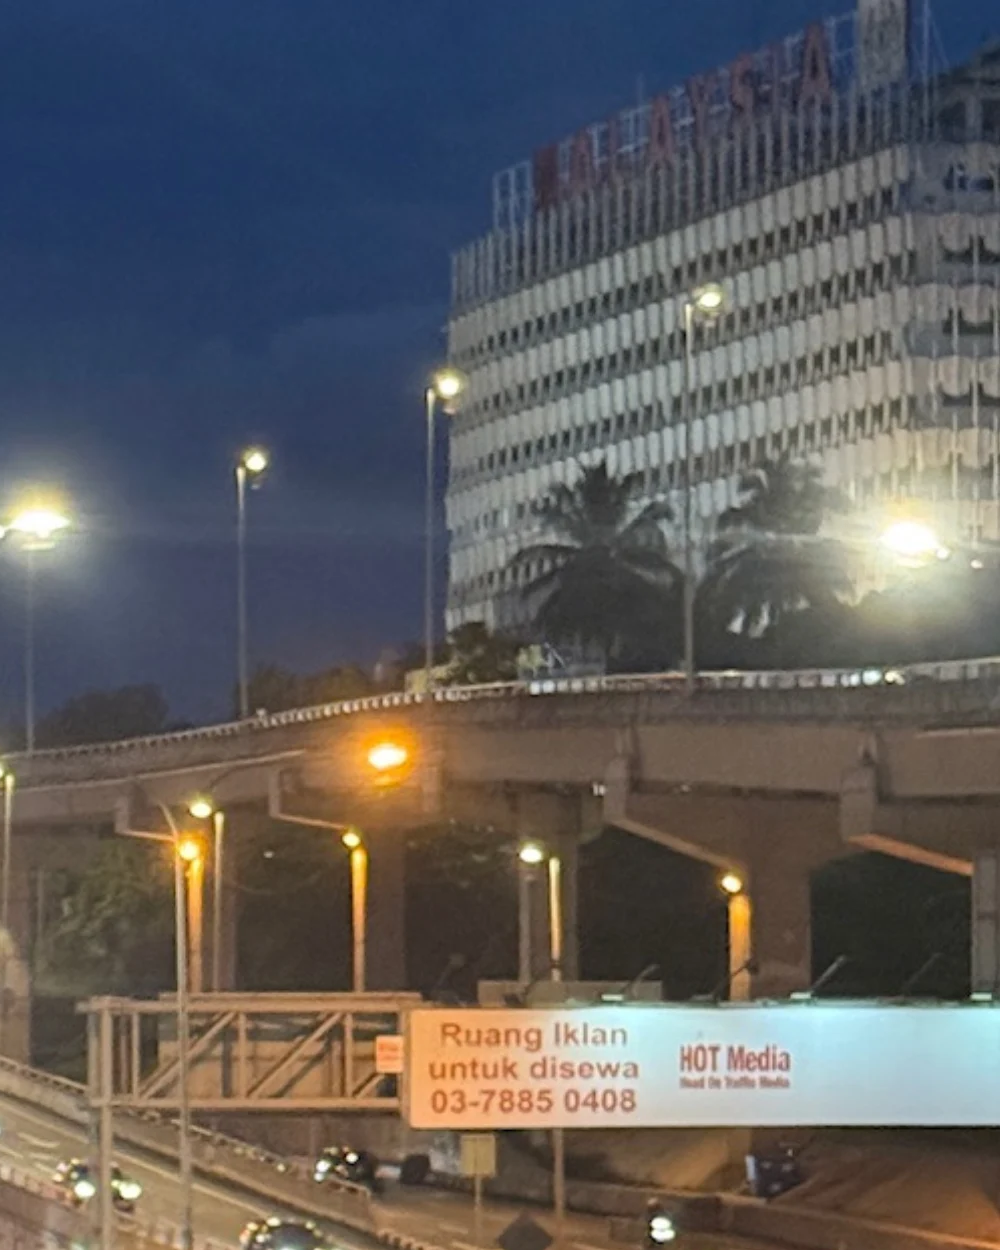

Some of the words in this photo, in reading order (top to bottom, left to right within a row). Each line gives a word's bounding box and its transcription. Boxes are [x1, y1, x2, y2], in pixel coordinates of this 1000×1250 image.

[440, 1022, 542, 1052] Ruang
[554, 1022, 628, 1046] Iklan
[428, 1057, 518, 1080] untuk
[530, 1056, 639, 1080] disewa
[680, 1044, 719, 1072] HOT
[727, 1043, 791, 1072] Media
[431, 1089, 553, 1114] 03-7885
[564, 1088, 637, 1113] 0408
